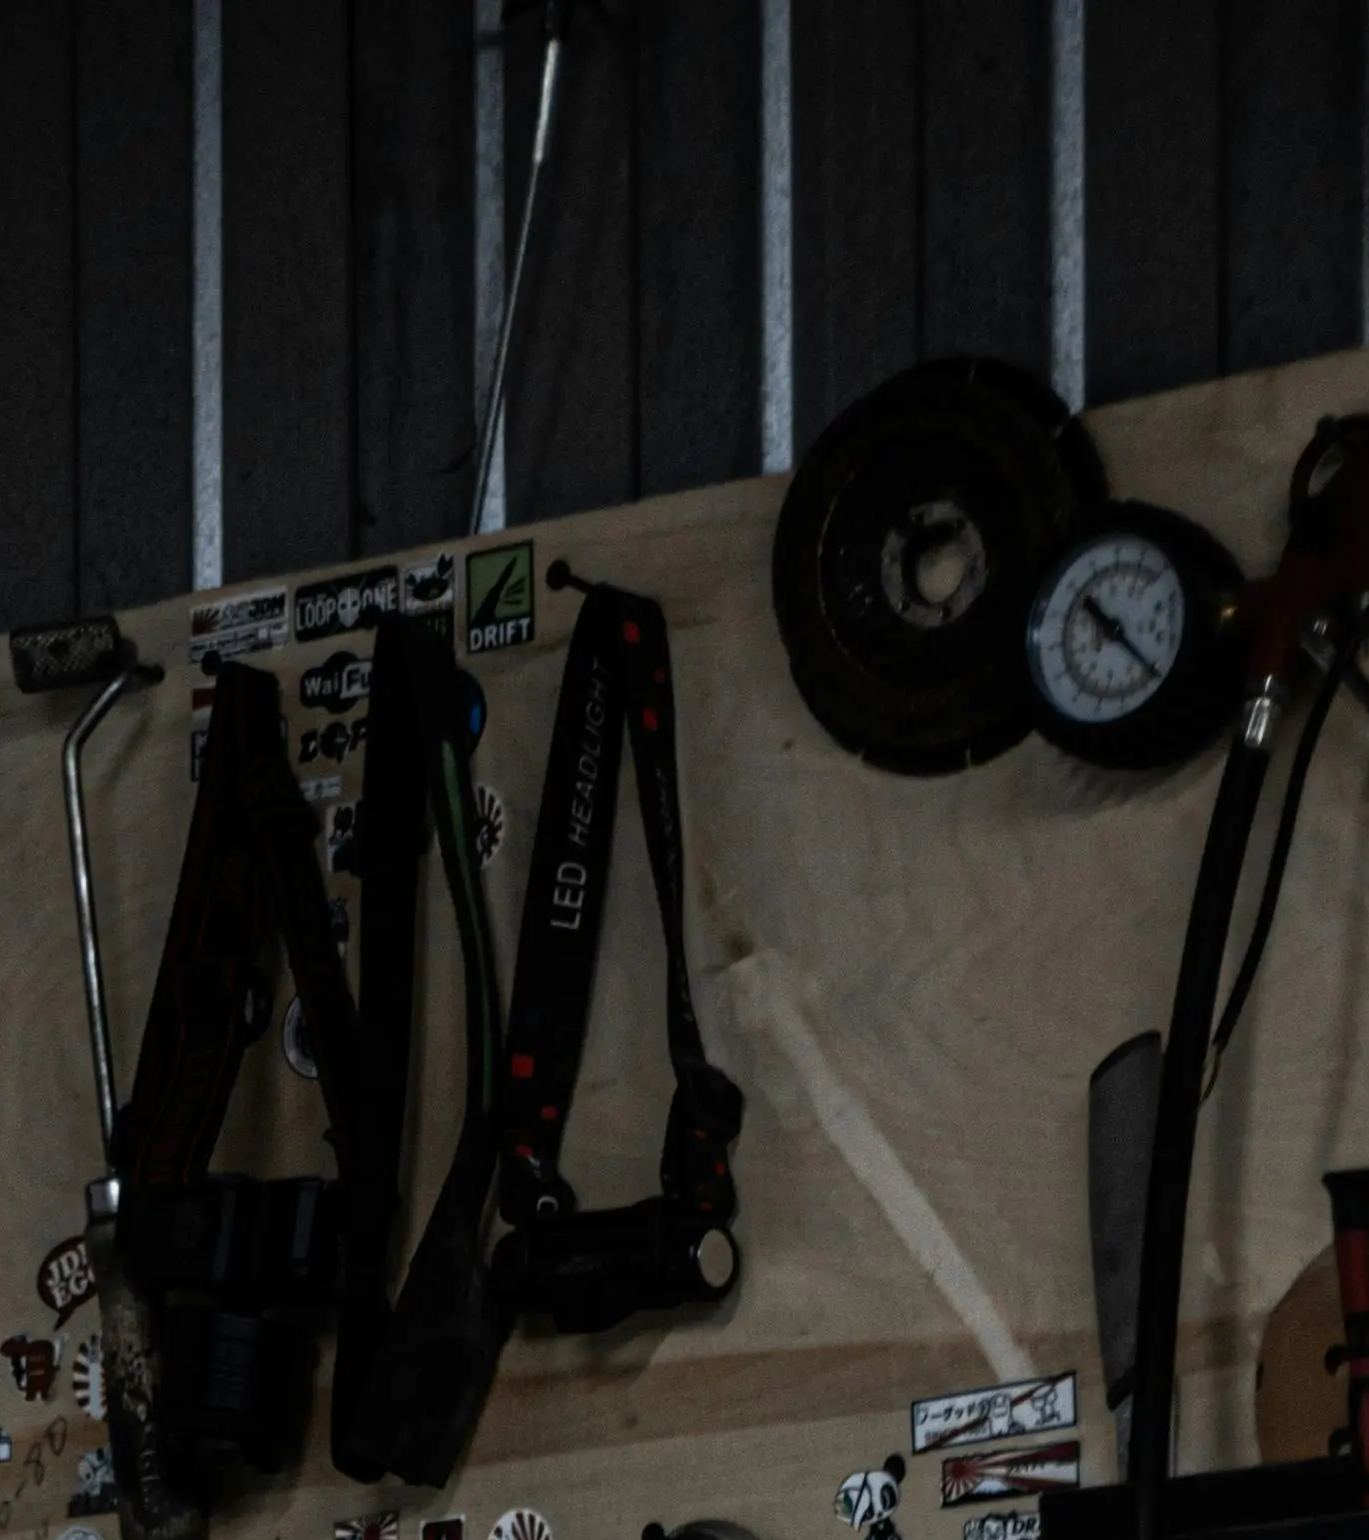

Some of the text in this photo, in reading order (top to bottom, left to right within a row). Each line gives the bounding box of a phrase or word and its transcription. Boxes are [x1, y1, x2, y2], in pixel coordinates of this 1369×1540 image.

[295, 600, 337, 630] LOOP
[469, 617, 532, 651] DRIFT
[549, 654, 611, 931] LED HEADLIGHT
